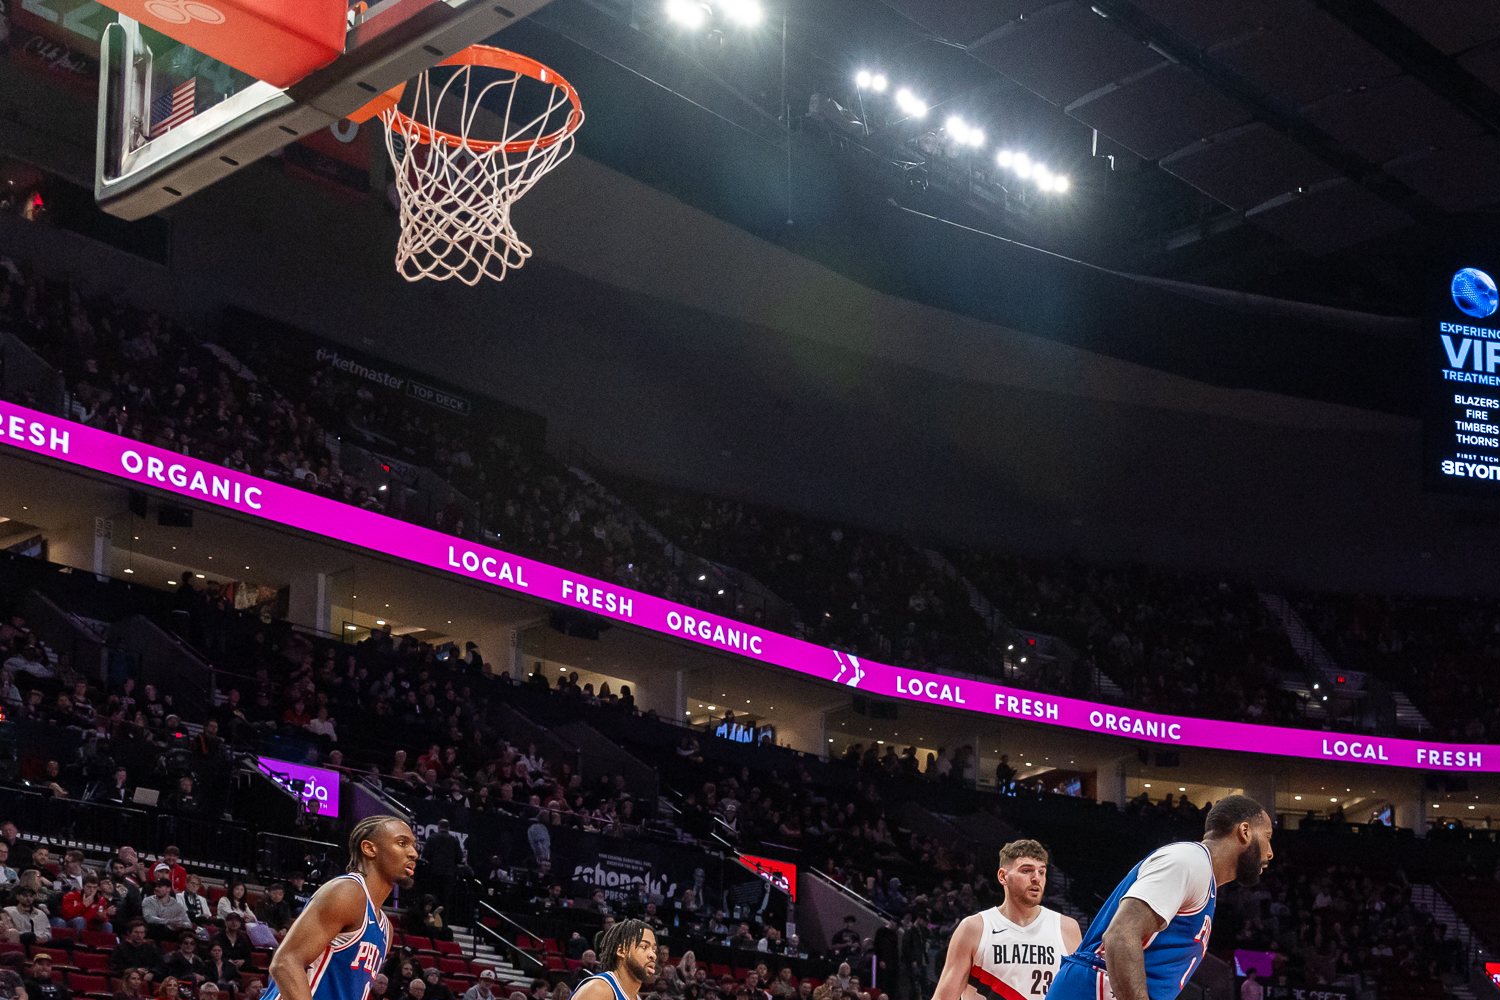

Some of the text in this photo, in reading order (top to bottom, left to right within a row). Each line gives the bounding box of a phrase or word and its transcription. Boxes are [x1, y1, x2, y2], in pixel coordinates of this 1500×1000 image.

[413, 384, 434, 400] TOP
[436, 393, 464, 411] DECK
[1455, 395, 1499, 408] BLAZERS
[1455, 421, 1499, 434] TIMBERS
[1467, 409, 1487, 420] FIRE
[0, 413, 70, 454] ESH
[1456, 434, 1498, 447] THORNS
[121, 451, 262, 509] ORGANIC
[449, 546, 528, 587] LOCAL
[562, 580, 632, 617] FRESH
[667, 612, 762, 654] ORGANIC
[897, 676, 965, 703] LOCAL
[996, 694, 1058, 719] FRESH
[1090, 711, 1180, 739] ORGANIC
[1323, 740, 1388, 760] LOCAL
[1417, 749, 1481, 766] FRESH
[992, 944, 1055, 965] BLAZERS
